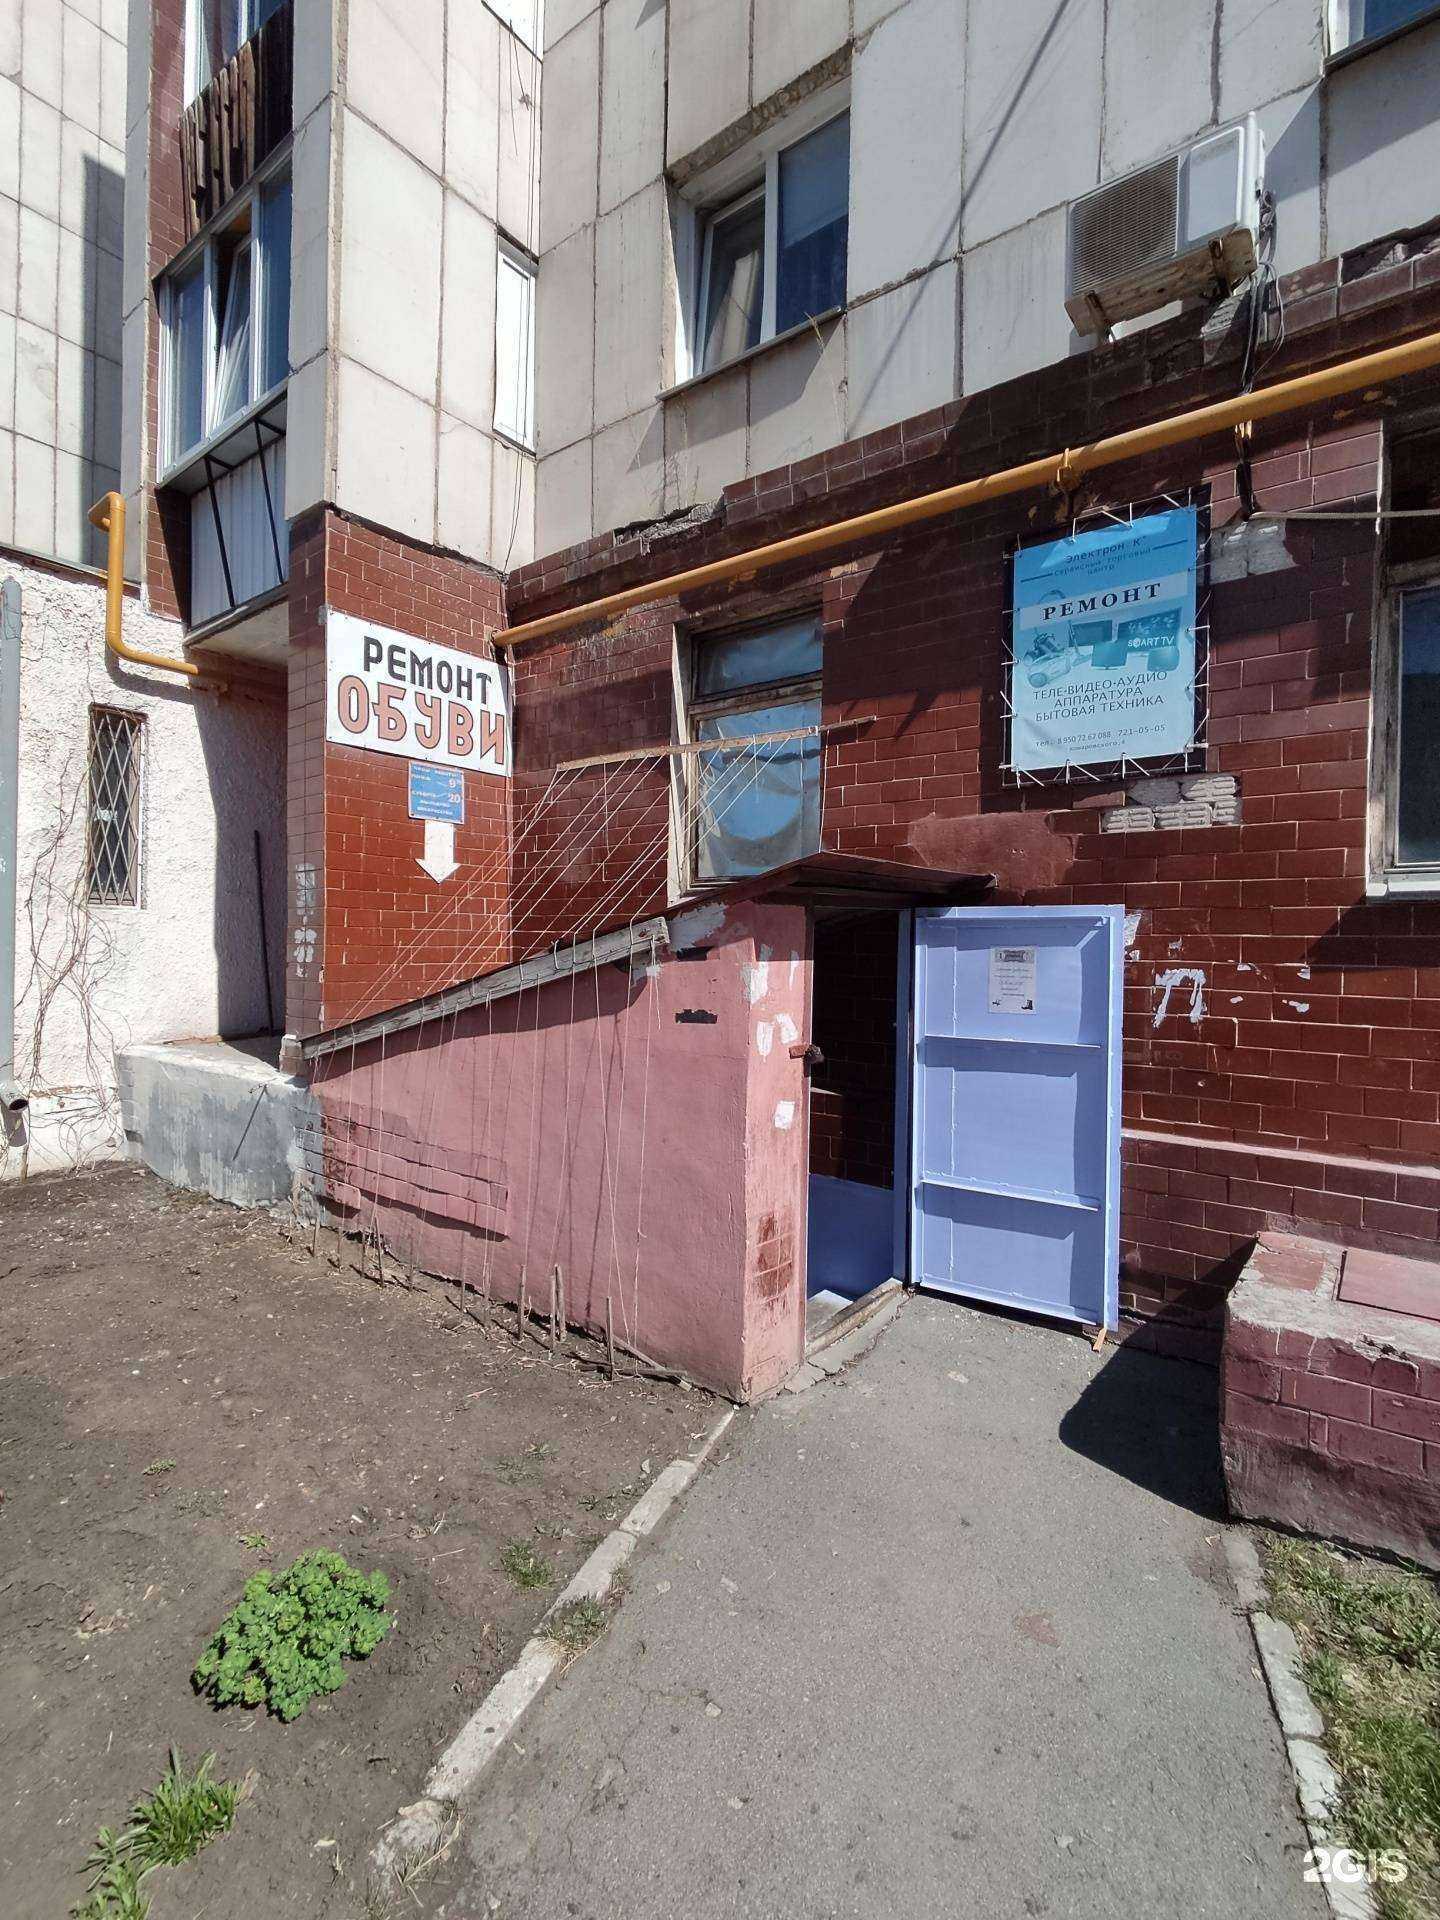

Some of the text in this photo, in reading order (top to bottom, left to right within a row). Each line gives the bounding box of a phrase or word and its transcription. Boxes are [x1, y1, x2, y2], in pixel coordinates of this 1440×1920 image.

[1043, 583, 1160, 620] РЕМОНТ
[1161, 636, 1175, 646] TV
[363, 635, 492, 705] РЕМОНТ
[1034, 671, 1168, 700] ТЕЛЕ-ВИДЕО-АУДИО
[1054, 687, 1143, 708] АППАРАТУРА
[338, 675, 505, 765] ОБУВИ
[1035, 695, 1165, 722] БЫТОВАЯ ТЕХНИКА
